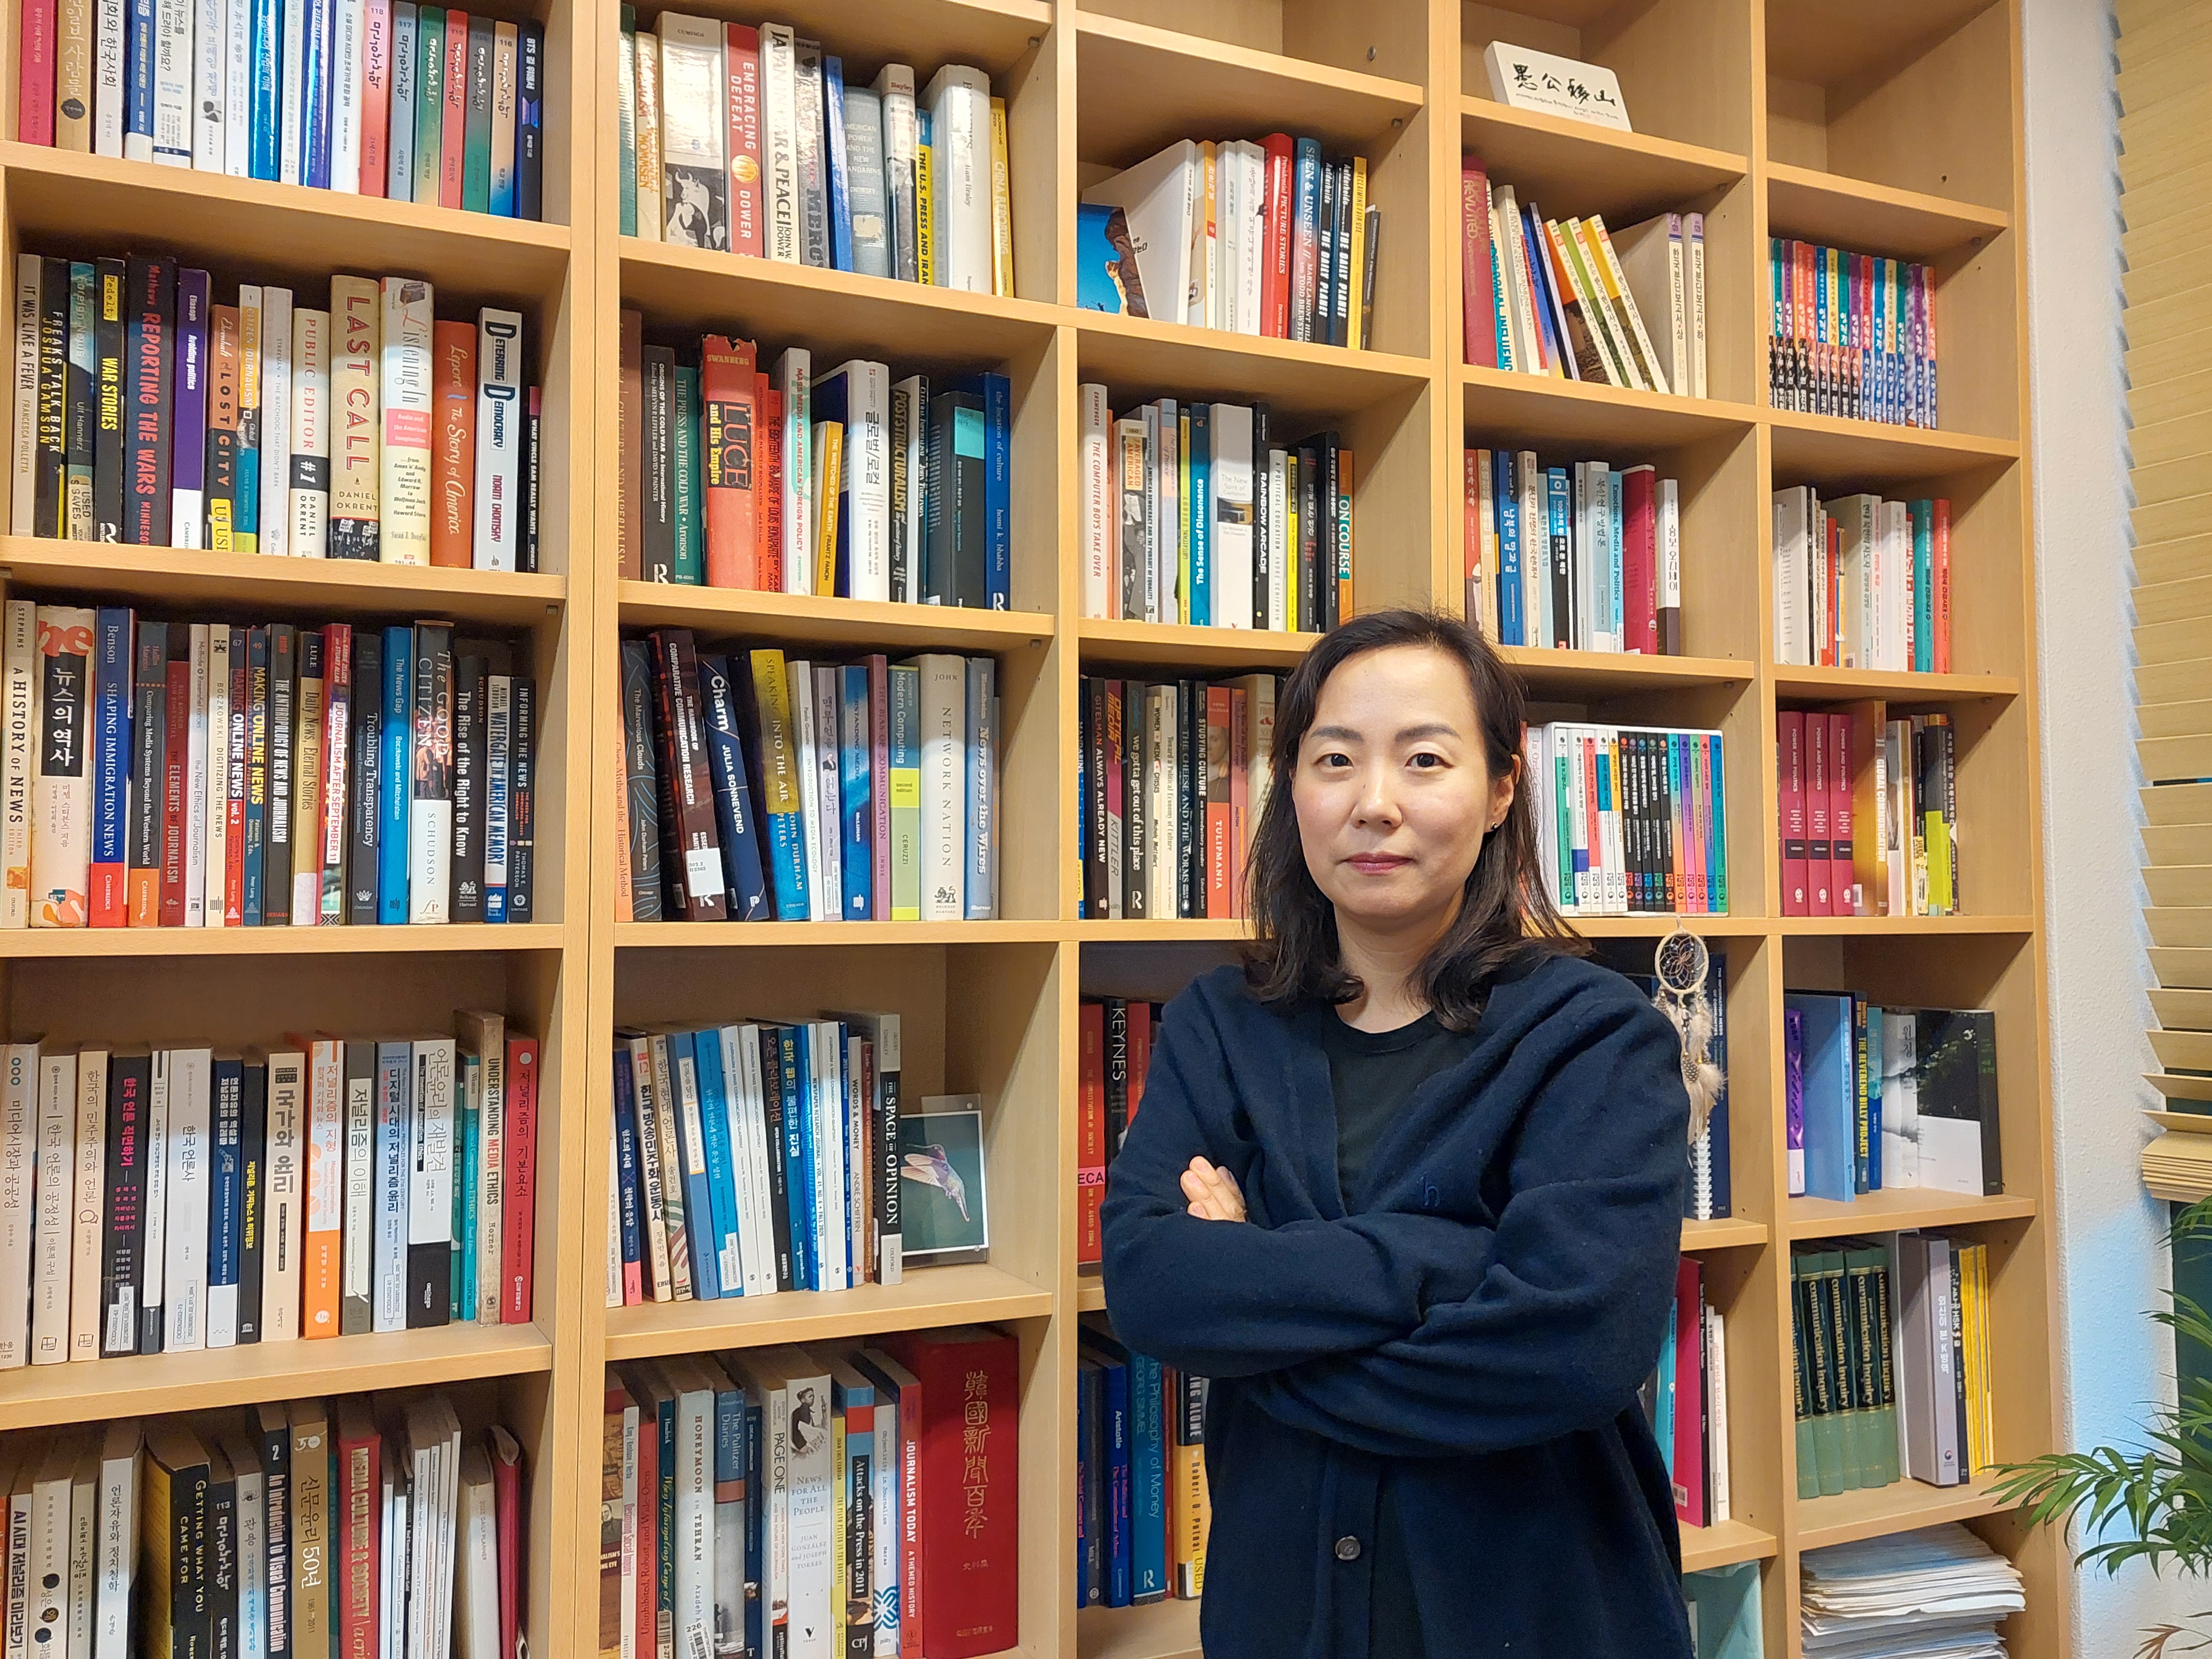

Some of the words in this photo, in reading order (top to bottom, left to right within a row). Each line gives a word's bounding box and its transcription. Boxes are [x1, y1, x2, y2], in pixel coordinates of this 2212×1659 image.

[160, 11, 171, 37] 드려야
[101, 37, 118, 87] 한국사회
[160, 40, 170, 71] 할까요?
[525, 38, 535, 54] BTS
[525, 66, 535, 89] 위에서
[730, 75, 743, 133] DEFEAT
[743, 62, 756, 150] EMBRACING
[639, 133, 649, 188] MOMMSEN
[1305, 146, 1315, 180] SEEN
[776, 168, 792, 220] PEACE
[919, 173, 927, 194] U.S.
[1304, 181, 1313, 191] &
[739, 189, 752, 238] DOWER
[920, 198, 928, 230] PRESS
[1279, 195, 1288, 234] PICTURE
[1303, 195, 1314, 248] UNSEEN
[921, 259, 929, 285] IRAN
[1278, 236, 1287, 275] STORIES
[1298, 275, 1306, 297] TODD
[50, 311, 64, 365] FREAKS
[347, 296, 370, 376] LAST
[1297, 299, 1305, 342] BREWSTER
[138, 312, 161, 404] REPORTING
[304, 318, 317, 378] PUBLIC
[101, 357, 118, 382] WAR
[50, 374, 62, 408] TALK
[101, 385, 118, 431] STORIES
[219, 372, 231, 426] LOST
[138, 412, 158, 441] THE
[303, 387, 315, 450] EDITOR
[346, 388, 370, 471] CALL
[451, 407, 463, 421] The
[710, 404, 720, 424] and
[48, 416, 60, 453] BACK
[443, 423, 467, 464] Story
[710, 427, 721, 444] His
[724, 404, 749, 487] LUCE
[865, 410, 881, 486] 글로벌/로컬
[1093, 441, 1101, 458] THE
[135, 449, 156, 495] WARS
[217, 434, 230, 487] CITY
[300, 461, 317, 483] #1
[449, 467, 461, 477] of
[708, 447, 722, 485] Empire
[1093, 459, 1101, 505] COMPUTER
[81, 491, 92, 519] USED
[299, 495, 307, 537] OKRENT
[308, 496, 317, 537] DANIEL
[445, 480, 466, 534] America
[1093, 507, 1101, 530] BOYS
[1339, 499, 1349, 522] ON
[1503, 508, 1516, 537] 남북의
[1338, 524, 1349, 574] COURSE
[1504, 542, 1516, 561] 말과
[1504, 565, 1517, 574] 글
[106, 625, 119, 664] Benson
[52, 667, 76, 725] 뉴스의
[105, 682, 118, 734] SHAPING
[457, 691, 471, 711] The
[711, 675, 730, 731] Charm
[896, 672, 906, 709] Modern
[11, 680, 26, 753] HISTORY
[457, 715, 471, 738] Rise
[772, 719, 783, 750] INTO
[49, 728, 74, 767] 역사
[231, 713, 244, 760] ONLINE
[457, 741, 471, 754] of
[896, 711, 906, 764] Computing
[942, 707, 952, 790] NETWORK
[11, 757, 21, 770] OF
[104, 737, 117, 820] IMMIGRATION
[229, 762, 243, 798] NEWS
[457, 757, 470, 775] the
[776, 753, 786, 777] THE
[1096, 748, 1105, 787] ALWAYS
[1876, 759, 1885, 789] GLOBAL
[9, 776, 24, 823] NEWS
[454, 779, 470, 809] Right
[722, 745, 734, 772] JULIA
[728, 774, 744, 834] SONNEVEND
[779, 781, 788, 802] AIR
[231, 802, 240, 816] vol.
[456, 812, 469, 823] to
[1096, 791, 1105, 837] ALREADY
[1877, 791, 1886, 862] COMMUNICATION
[103, 823, 115, 856] NEWS
[426, 812, 437, 885] SCHUDSON
[455, 827, 468, 857] Know
[942, 799, 952, 867] NATION
[1098, 839, 1106, 863] NEW
[1112, 1007, 1126, 1081] KEYNES
[426, 1048, 450, 1121] 언론윤리의
[1858, 1053, 1868, 1095] REVEREND
[486, 1058, 500, 1136] UNDERSTANDING
[1859, 1097, 1868, 1119] BILLY
[6, 1099, 23, 1171] 미디어시장과
[46, 1123, 61, 1149] 한국
[351, 1088, 370, 1163] 저널리즘의
[884, 1097, 896, 1140] SPACE
[425, 1122, 449, 1172] 재발견
[486, 1139, 499, 1169] MEDIA
[1859, 1120, 1868, 1158] PROJECT
[45, 1153, 61, 1187] 언론의
[349, 1168, 368, 1198] 이해
[486, 1171, 499, 1205] ETHICS
[4, 1173, 22, 1209] 공공성
[885, 1154, 897, 1225] OPINION
[44, 1191, 60, 1227] 공정성
[1808, 1281, 1824, 1368] communication
[1814, 1370, 1830, 1412] inquiry
[1148, 1384, 1161, 1452] Philosophy
[694, 1415, 702, 1493] HONEYMOON
[774, 1432, 785, 1464] PAGE
[1150, 1457, 1161, 1470] of
[774, 1466, 785, 1494] ONE
[854, 1460, 866, 1497] Attacks
[905, 1439, 917, 1506] JOURNALISM
[195, 1480, 206, 1540] GETTING
[300, 1475, 321, 1543] 신문윤리
[855, 1499, 863, 1513] on
[1150, 1473, 1161, 1518] Money
[13, 1511, 27, 1524] AI
[180, 1515, 189, 1553] CAME
[856, 1514, 866, 1530] the
[906, 1509, 916, 1543] TODAY
[13, 1526, 26, 1549] 시대
[694, 1514, 702, 1562] TEHRAN
[854, 1531, 866, 1558] Press
[11, 1552, 26, 1599] 저널리즘
[180, 1557, 189, 1584] FOR
[195, 1544, 204, 1581] WHAT
[300, 1546, 322, 1590] 50년
[855, 1559, 865, 1570] in
[1194, 1557, 1203, 1590] USED
[195, 1585, 204, 1613] YOU
[855, 1571, 866, 1594] 2011
[9, 1602, 24, 1649] 미리보기
